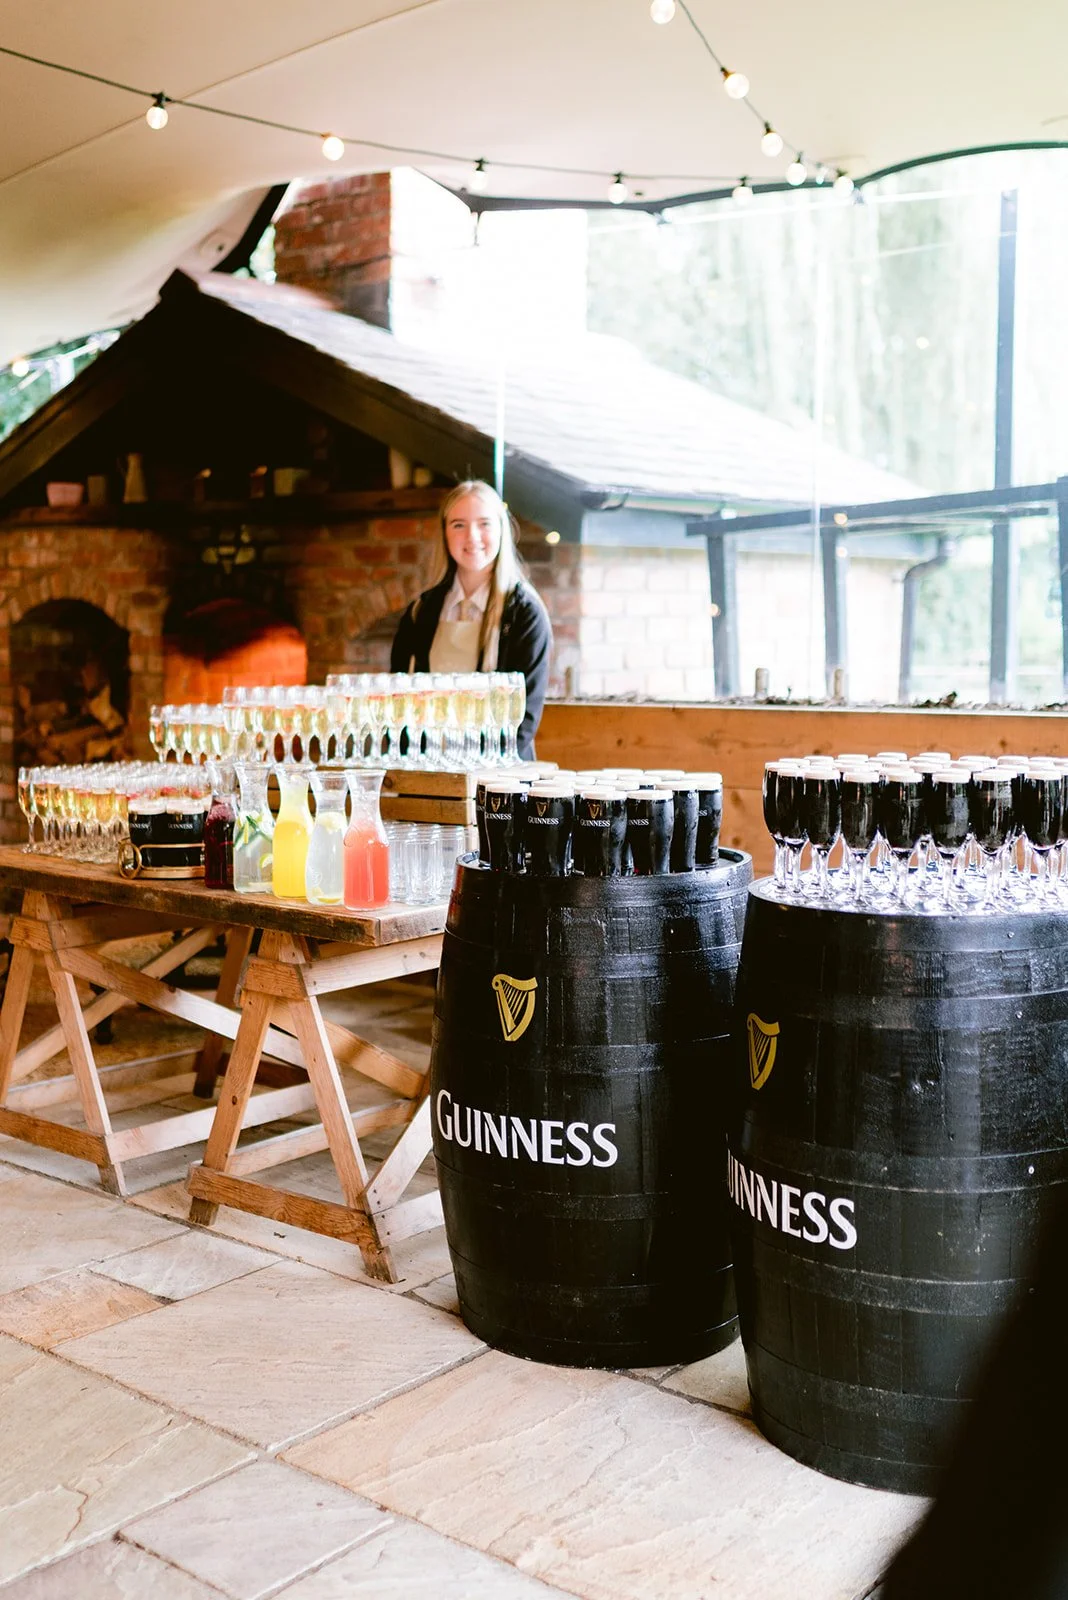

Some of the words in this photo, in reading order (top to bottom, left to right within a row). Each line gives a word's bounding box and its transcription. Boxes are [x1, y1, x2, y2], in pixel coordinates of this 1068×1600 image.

[527, 815, 560, 826] GUINNESS
[437, 1089, 618, 1168] GUINNESS
[726, 1132, 857, 1250] UINNESS
